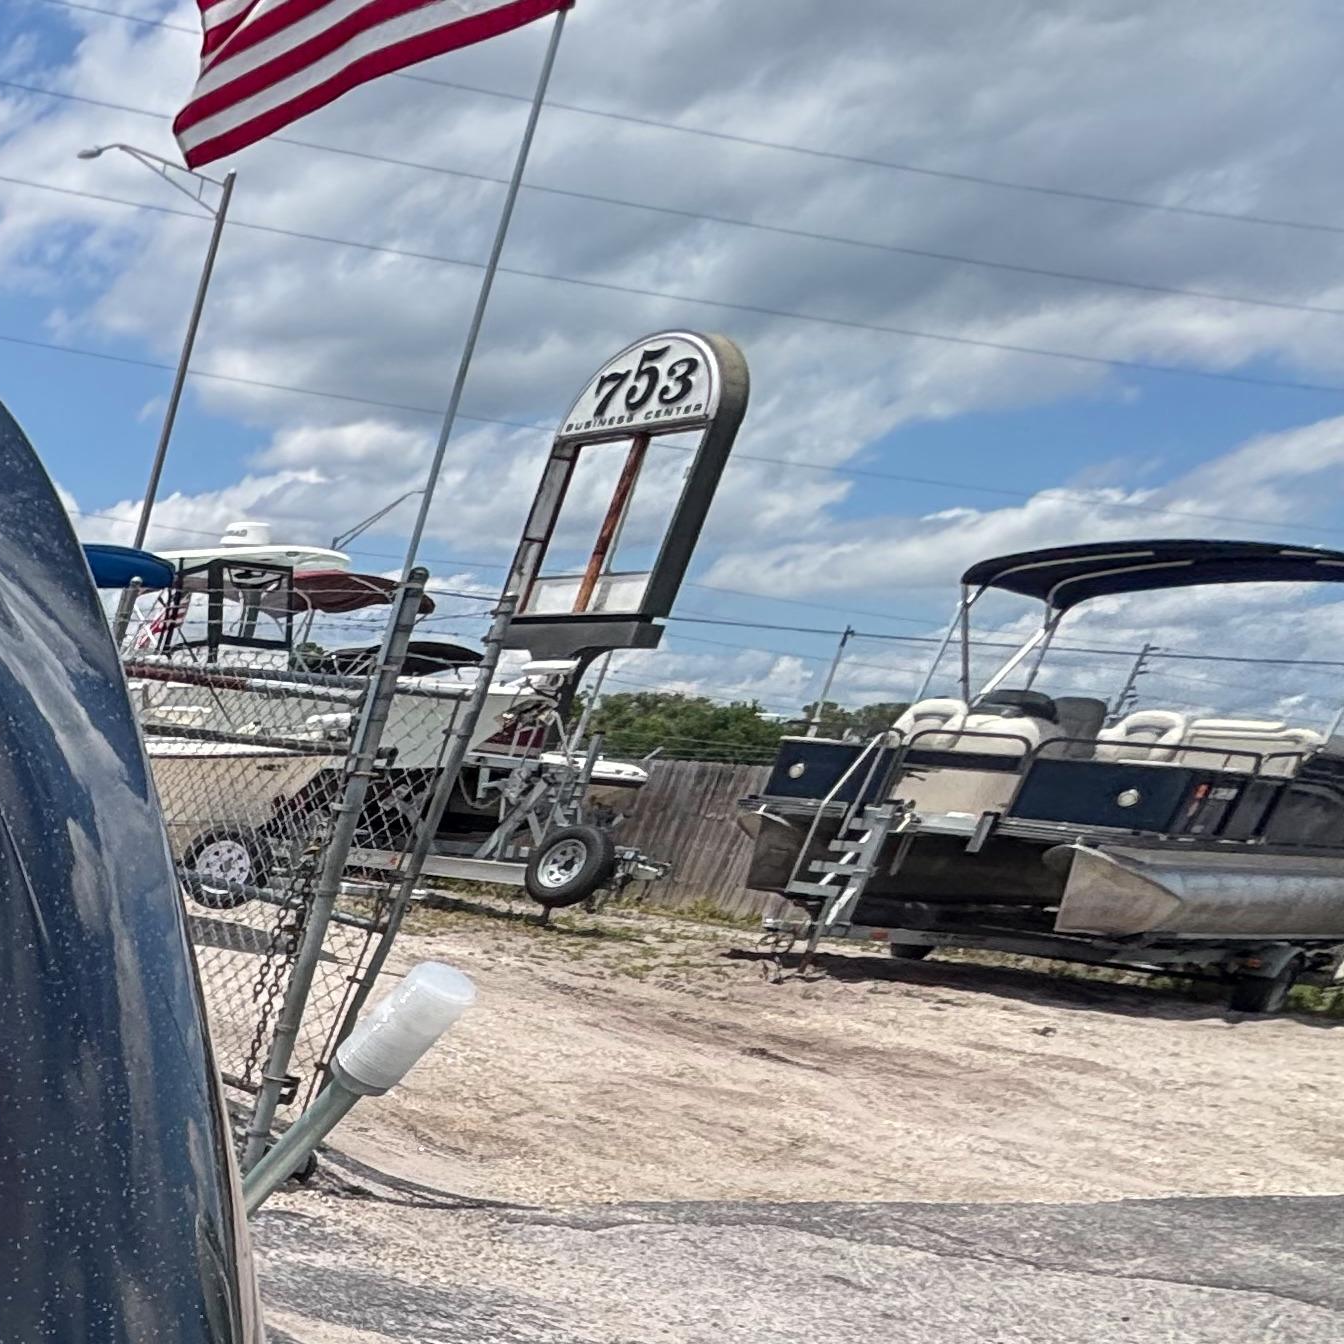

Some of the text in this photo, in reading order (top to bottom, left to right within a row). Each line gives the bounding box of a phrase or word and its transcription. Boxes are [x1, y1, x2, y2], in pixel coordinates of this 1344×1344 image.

[593, 345, 699, 418] 753
[565, 403, 704, 433] BUSINESS CENTER
